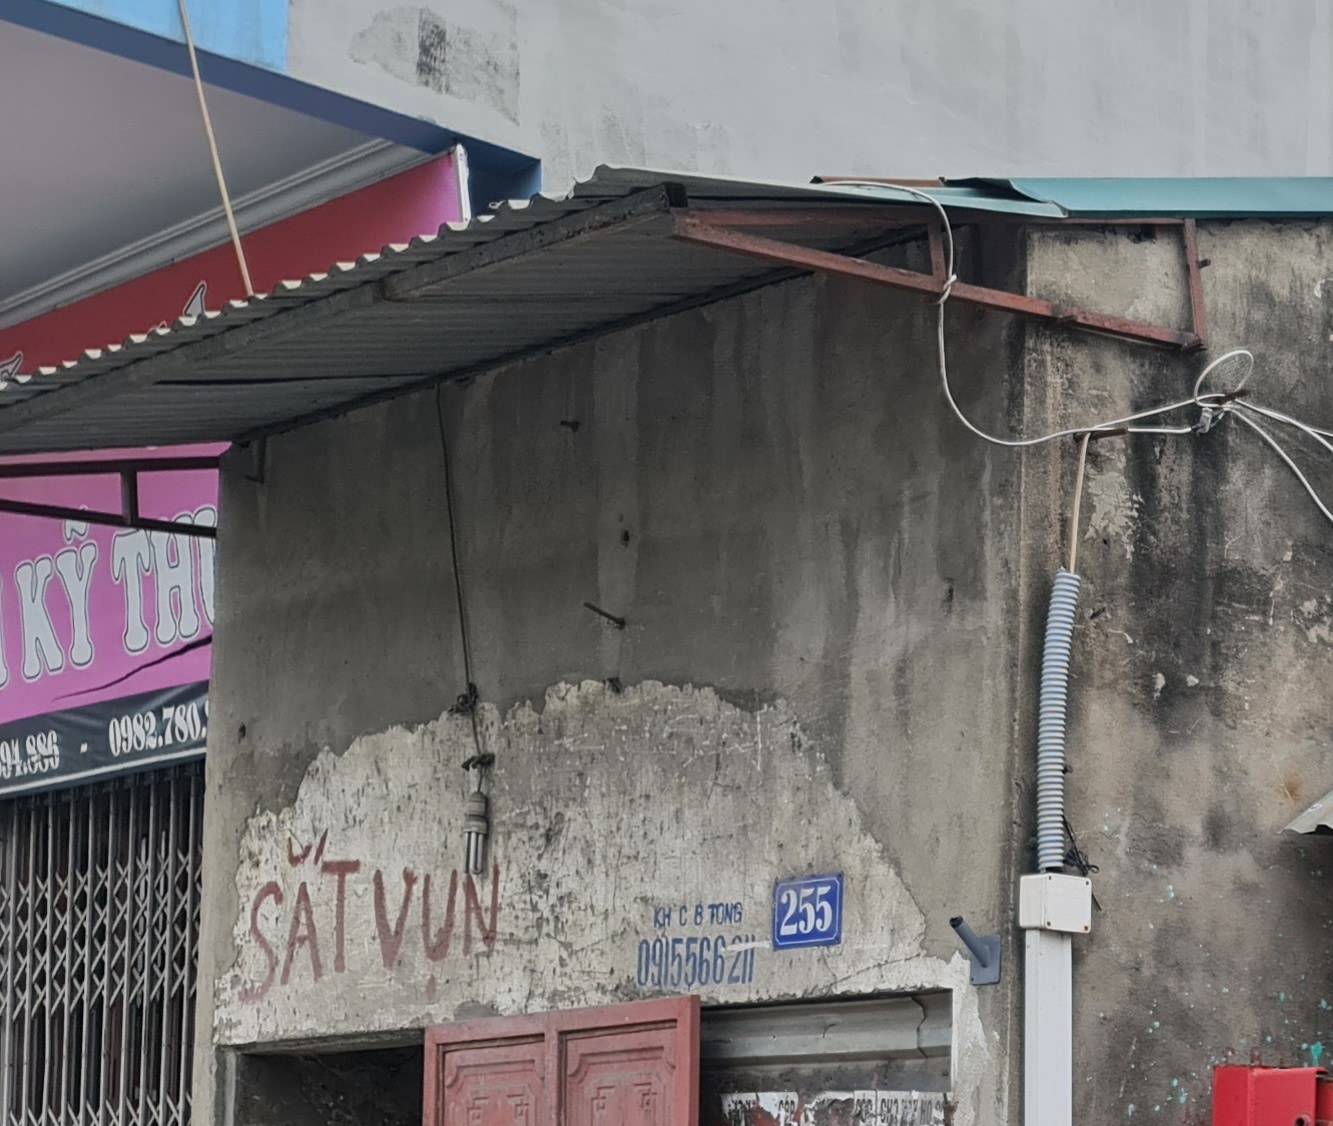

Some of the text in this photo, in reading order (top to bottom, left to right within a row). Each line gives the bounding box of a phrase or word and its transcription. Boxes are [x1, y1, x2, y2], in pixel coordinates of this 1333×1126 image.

[109, 700, 209, 758] 0982.780.
[239, 829, 361, 1004] SẮT
[780, 885, 833, 936] 255
